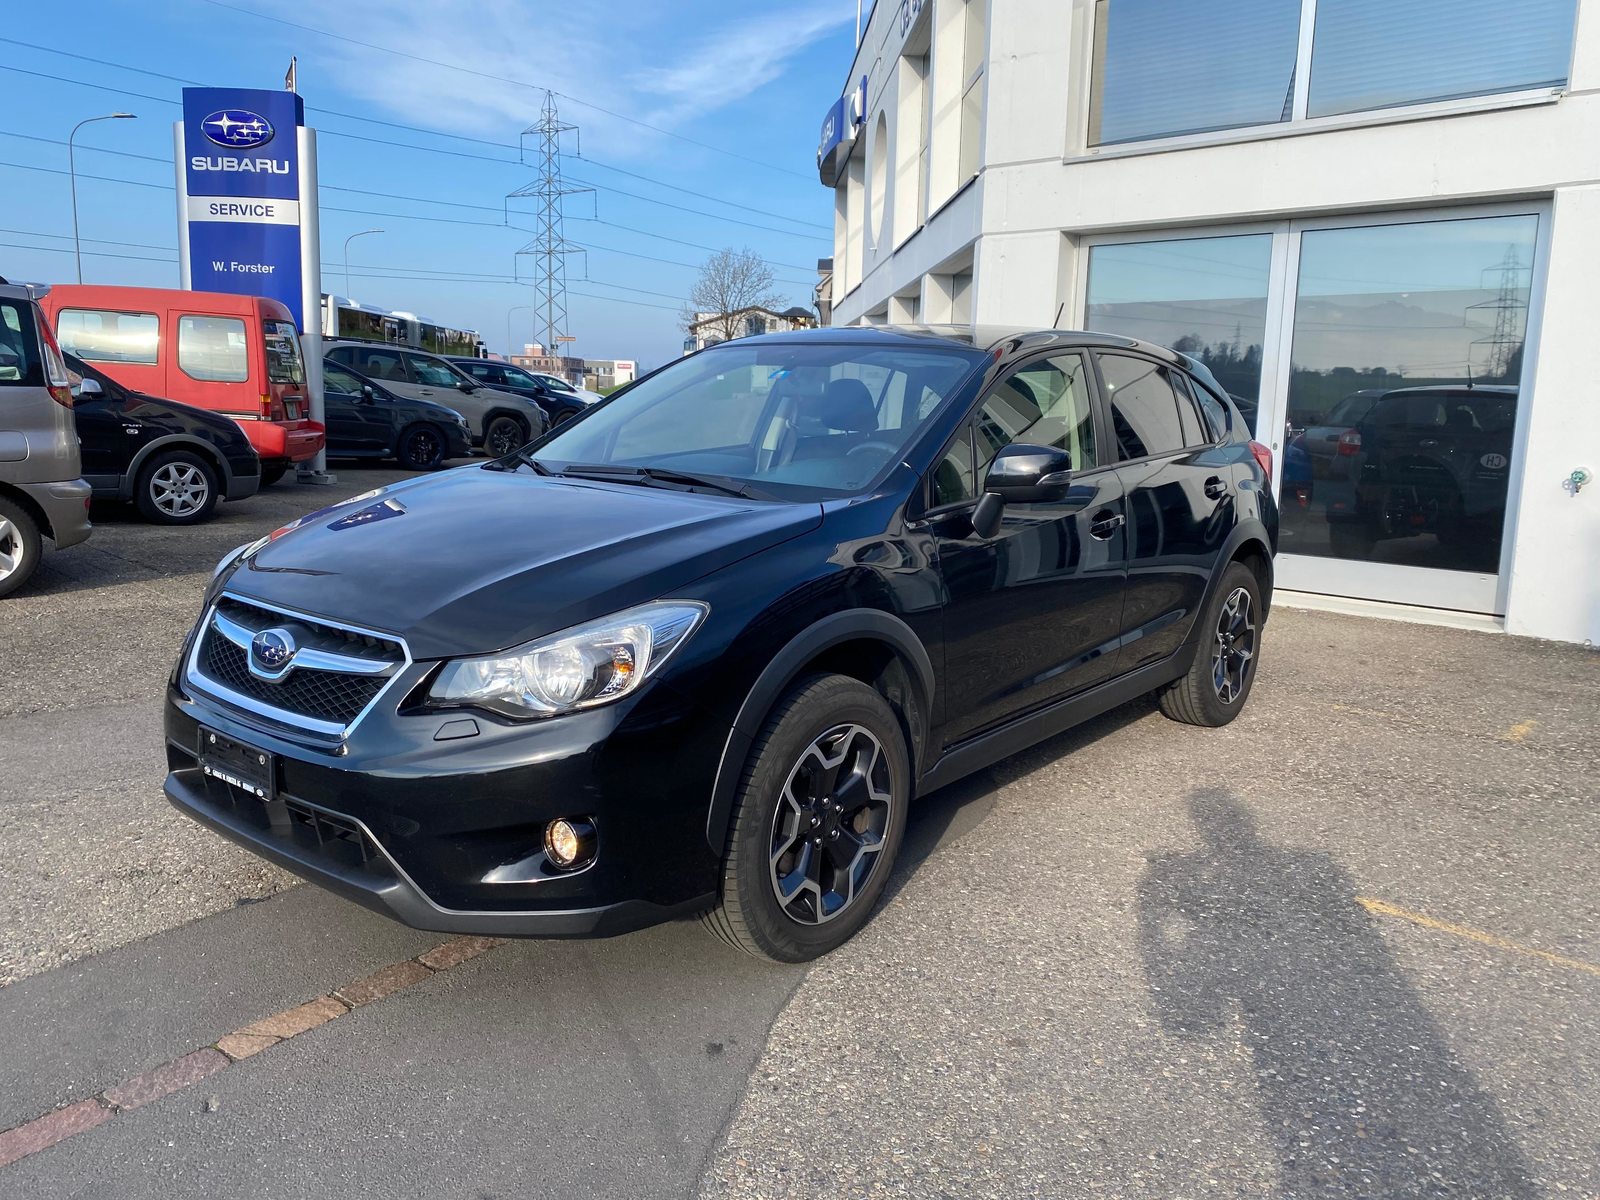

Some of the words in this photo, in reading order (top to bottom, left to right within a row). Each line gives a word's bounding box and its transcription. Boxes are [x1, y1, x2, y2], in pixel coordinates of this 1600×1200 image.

[191, 156, 290, 174] SUBARU
[209, 203, 275, 217] SERVICE
[212, 260, 227, 272] W.
[230, 261, 275, 274] Forster
